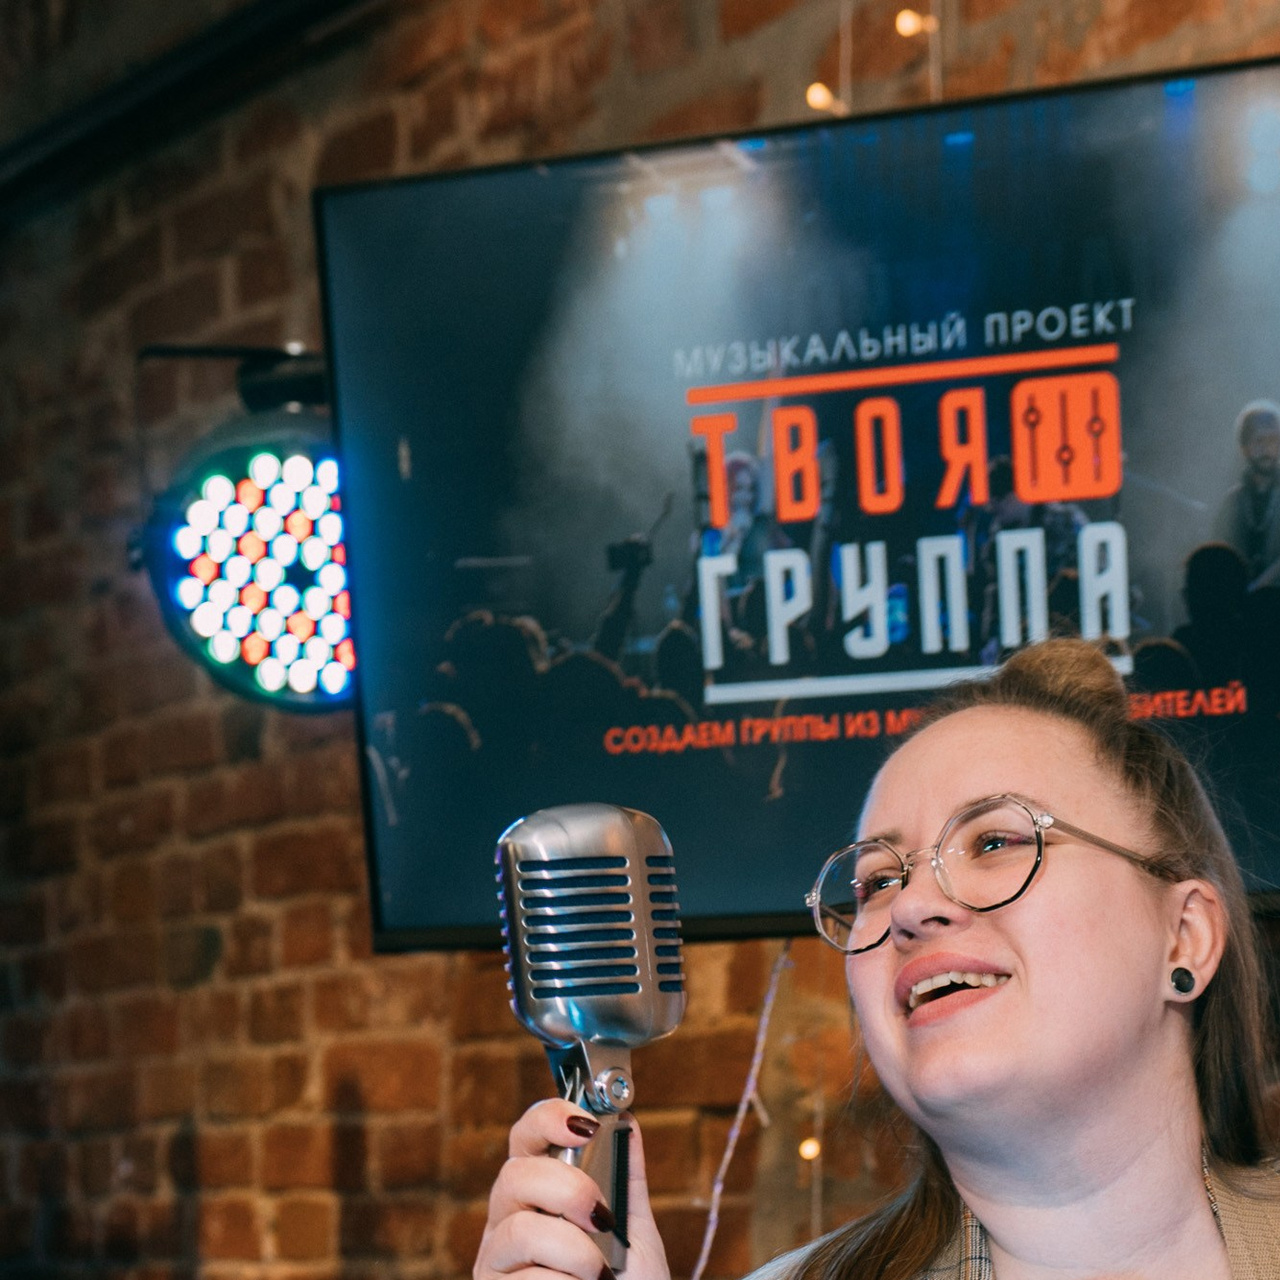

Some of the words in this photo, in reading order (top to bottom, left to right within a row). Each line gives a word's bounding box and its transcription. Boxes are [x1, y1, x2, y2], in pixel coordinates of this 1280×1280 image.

[673, 312, 967, 378] МУЗЫКАЛЬНЫЙ
[985, 298, 1136, 346] ПРОЕКТ
[692, 388, 989, 527] ТВОЯ
[699, 521, 1132, 669] ГРУППА
[740, 713, 840, 746] ГРУППЫ
[844, 709, 880, 738] ИЗ
